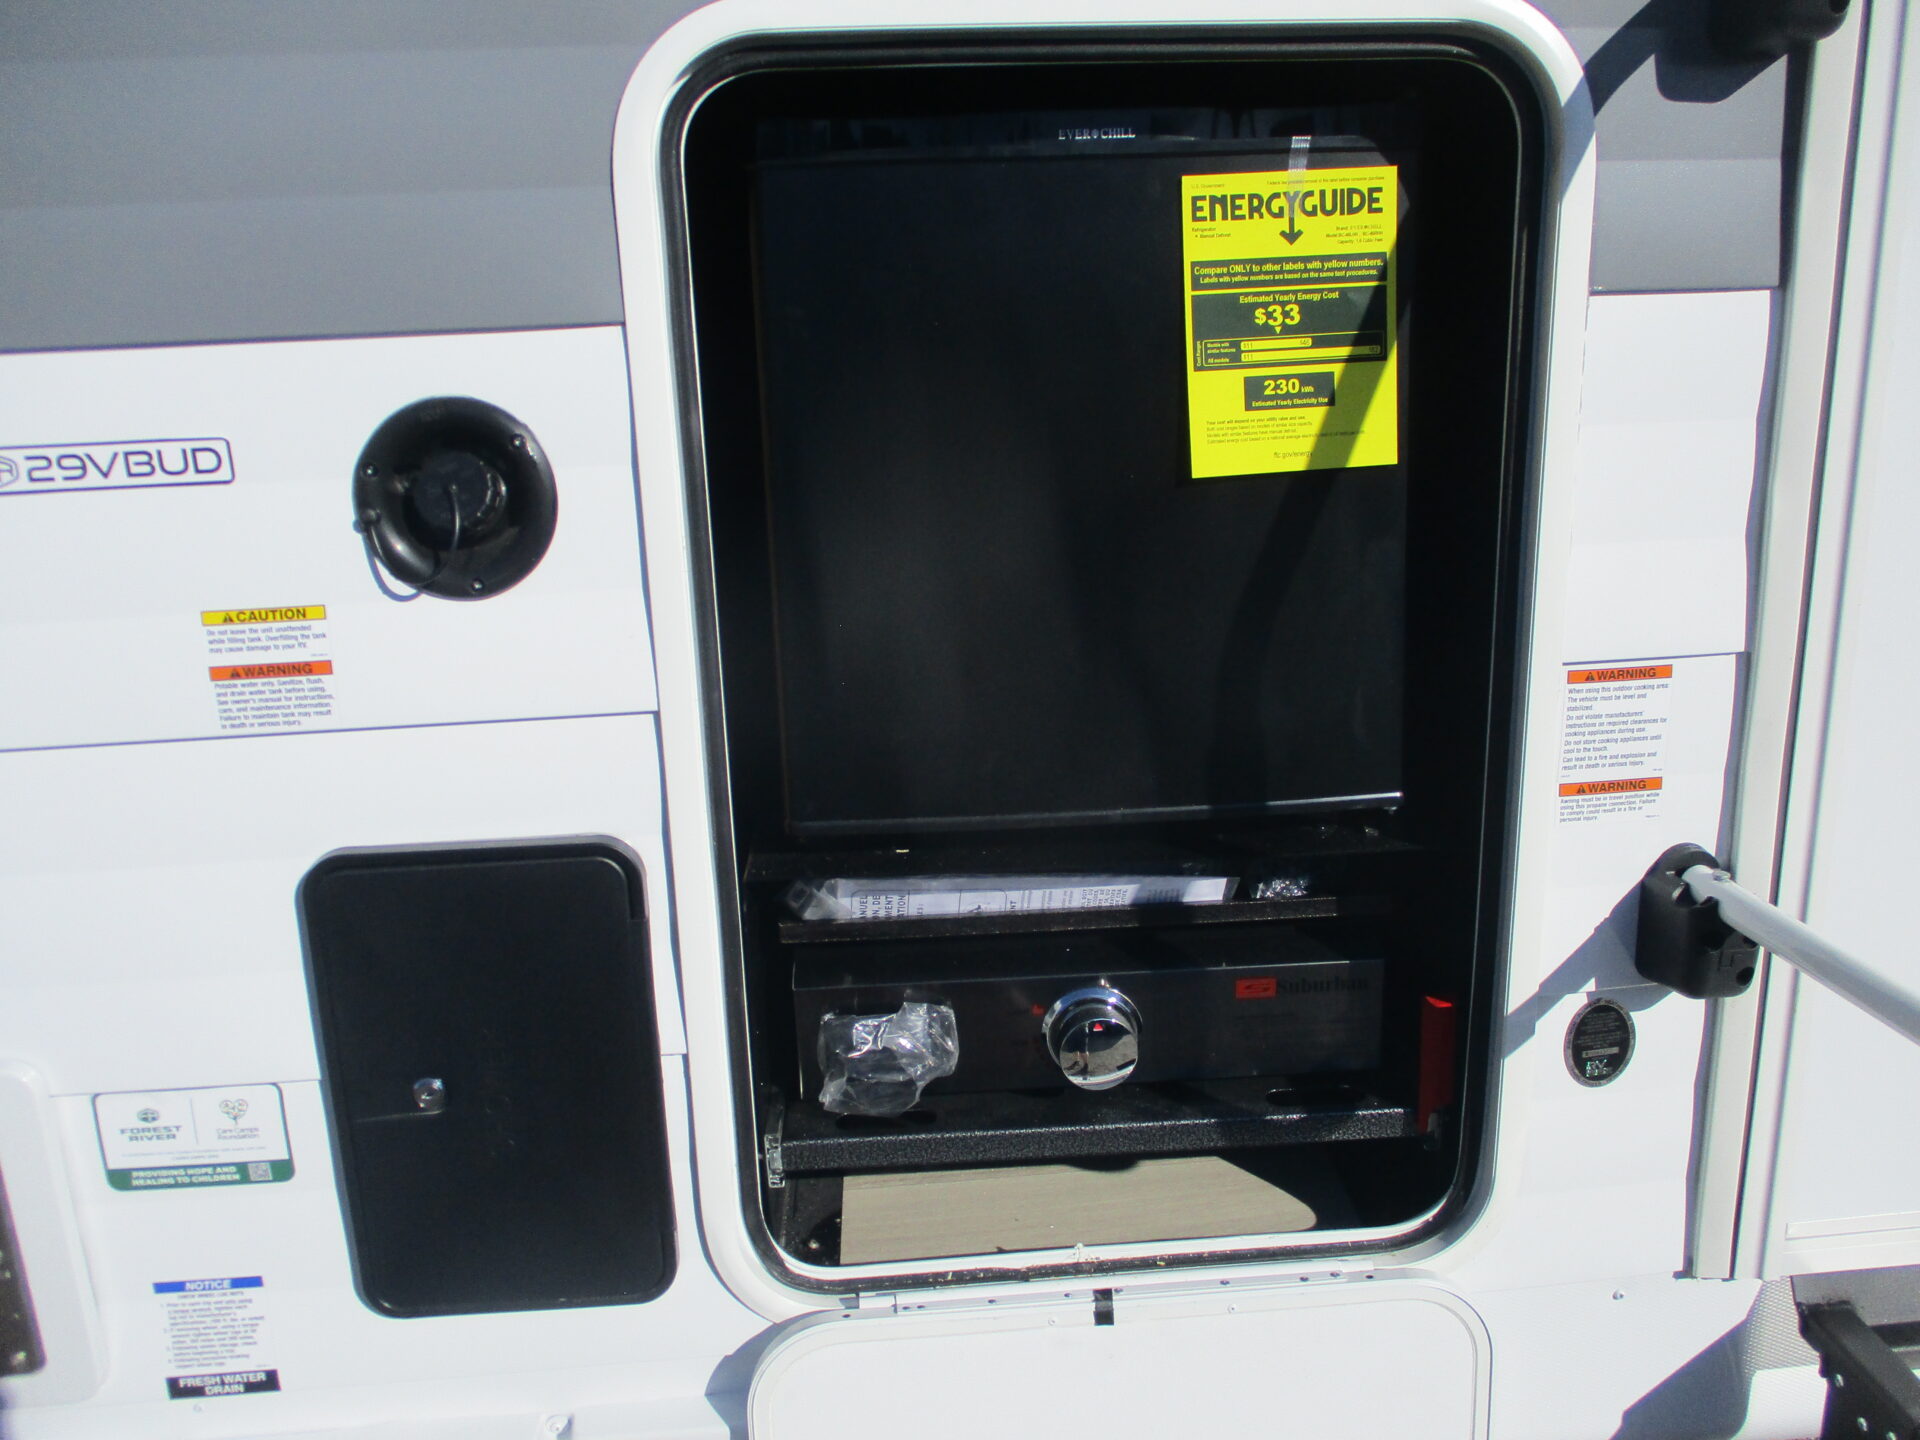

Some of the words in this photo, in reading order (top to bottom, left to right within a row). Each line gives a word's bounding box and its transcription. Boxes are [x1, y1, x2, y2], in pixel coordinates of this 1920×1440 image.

[1101, 128, 1136, 139] CHILL
[1191, 187, 1383, 221] ENERGYGUIDE
[1194, 264, 1227, 276] Compare
[1229, 263, 1250, 272] ONLY
[1252, 263, 1260, 271] to
[1262, 262, 1280, 271] other
[1282, 261, 1304, 270] labels
[1306, 260, 1322, 269] with
[1324, 259, 1347, 270] yellow
[1349, 257, 1384, 267] numbers.
[1240, 293, 1273, 302] Estimated
[1275, 292, 1295, 303] Yearly
[1297, 291, 1321, 302] Energy
[1322, 291, 1339, 299] Cost
[1254, 303, 1301, 326] $33
[1263, 378, 1300, 395] 230
[1301, 385, 1315, 393] kWh
[1277, 398, 1292, 406] Yearly
[1293, 397, 1317, 406] Electricity
[23, 447, 222, 482] 29VBUD
[236, 608, 306, 622] CAUTION
[241, 664, 313, 678] WARNING
[1596, 668, 1656, 681] WARNING
[1588, 780, 1647, 793] WARNING
[120, 1125, 182, 1134] FOREST
[128, 1133, 176, 1142] RIVER
[179, 1376, 220, 1387] FRESH
[222, 1372, 266, 1384] WATER
[205, 1384, 245, 1395] DRAIN
